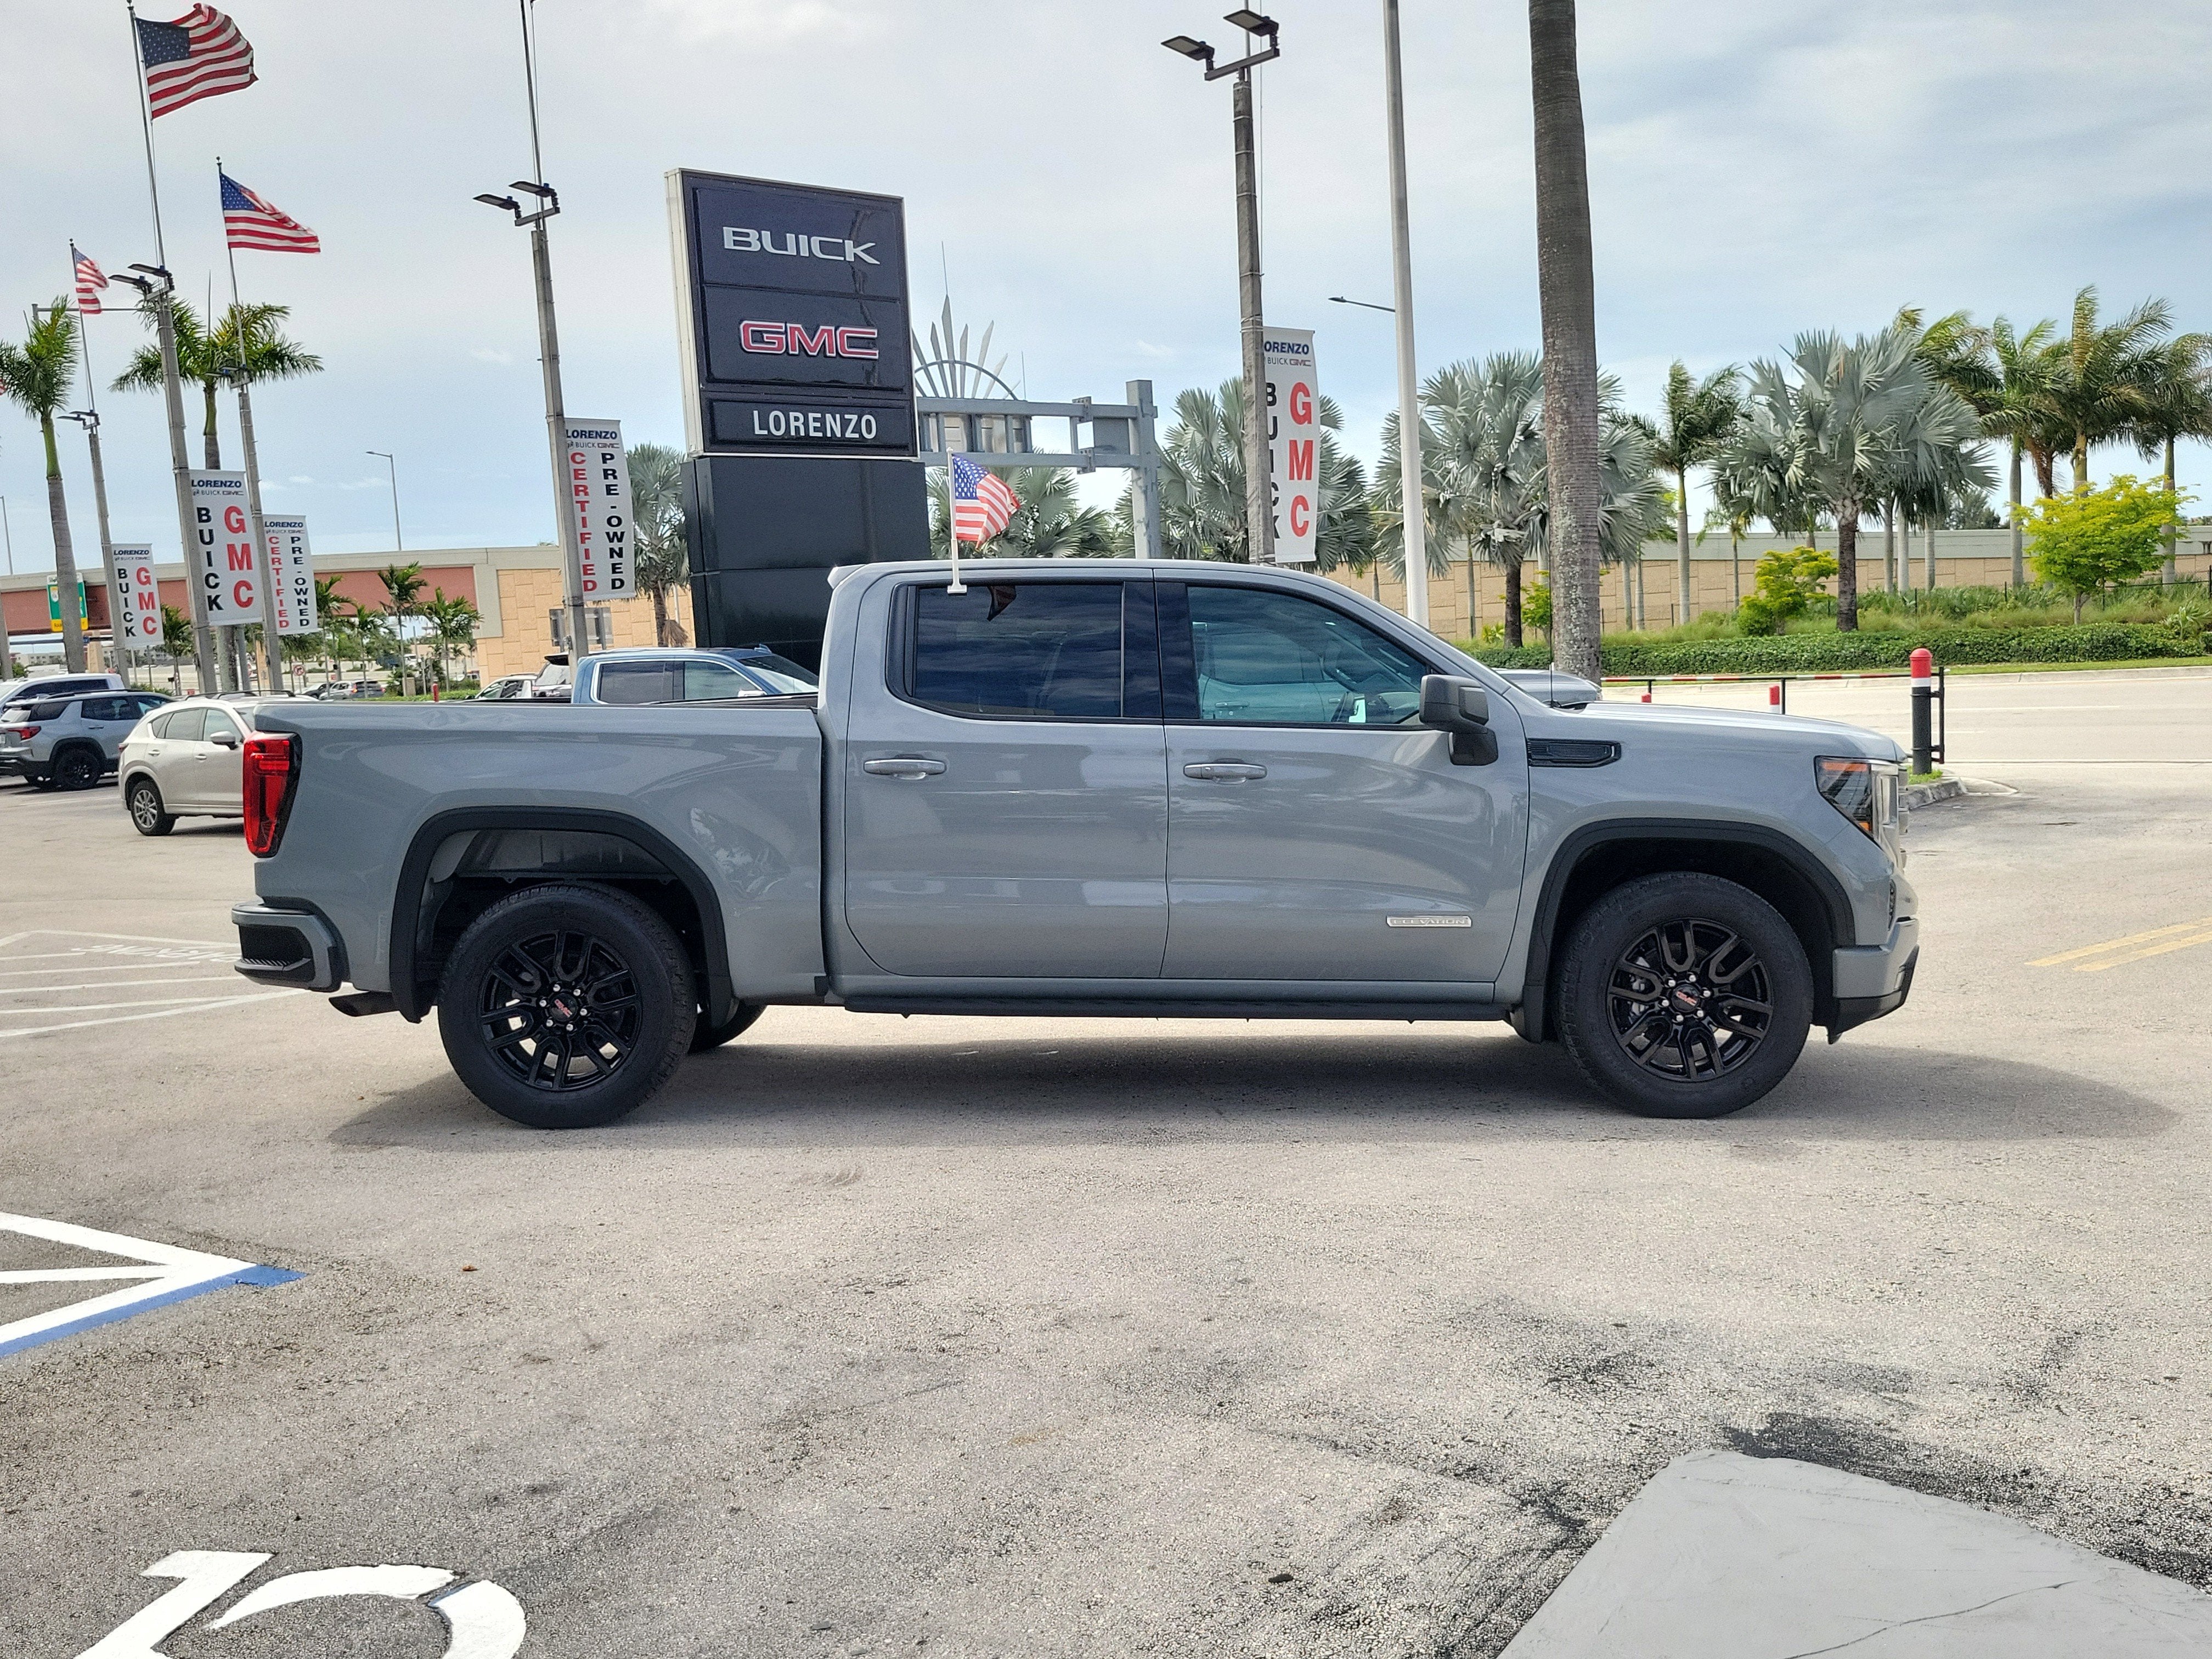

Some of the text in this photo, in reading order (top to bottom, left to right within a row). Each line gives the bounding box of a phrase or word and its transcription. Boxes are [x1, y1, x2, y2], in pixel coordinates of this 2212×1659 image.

[722, 226, 881, 265] BUICK
[740, 320, 879, 360] GMC
[1264, 341, 1310, 355] ORENZO
[1267, 357, 1311, 367] BUICK GMC
[566, 430, 617, 439] LORENZO
[753, 410, 877, 439] LORENZO
[191, 479, 242, 488] LORENZO
[1289, 382, 1313, 538] GMC
[570, 452, 597, 592] CERTIFIED
[601, 452, 625, 590] PRE-OWNED
[196, 506, 224, 612] BUICK
[224, 505, 254, 608] GMC
[269, 537, 290, 628] CERTIFIED
[290, 536, 310, 627] PRE-OWNED
[117, 568, 137, 637] BUICK
[136, 567, 157, 635] GMC
